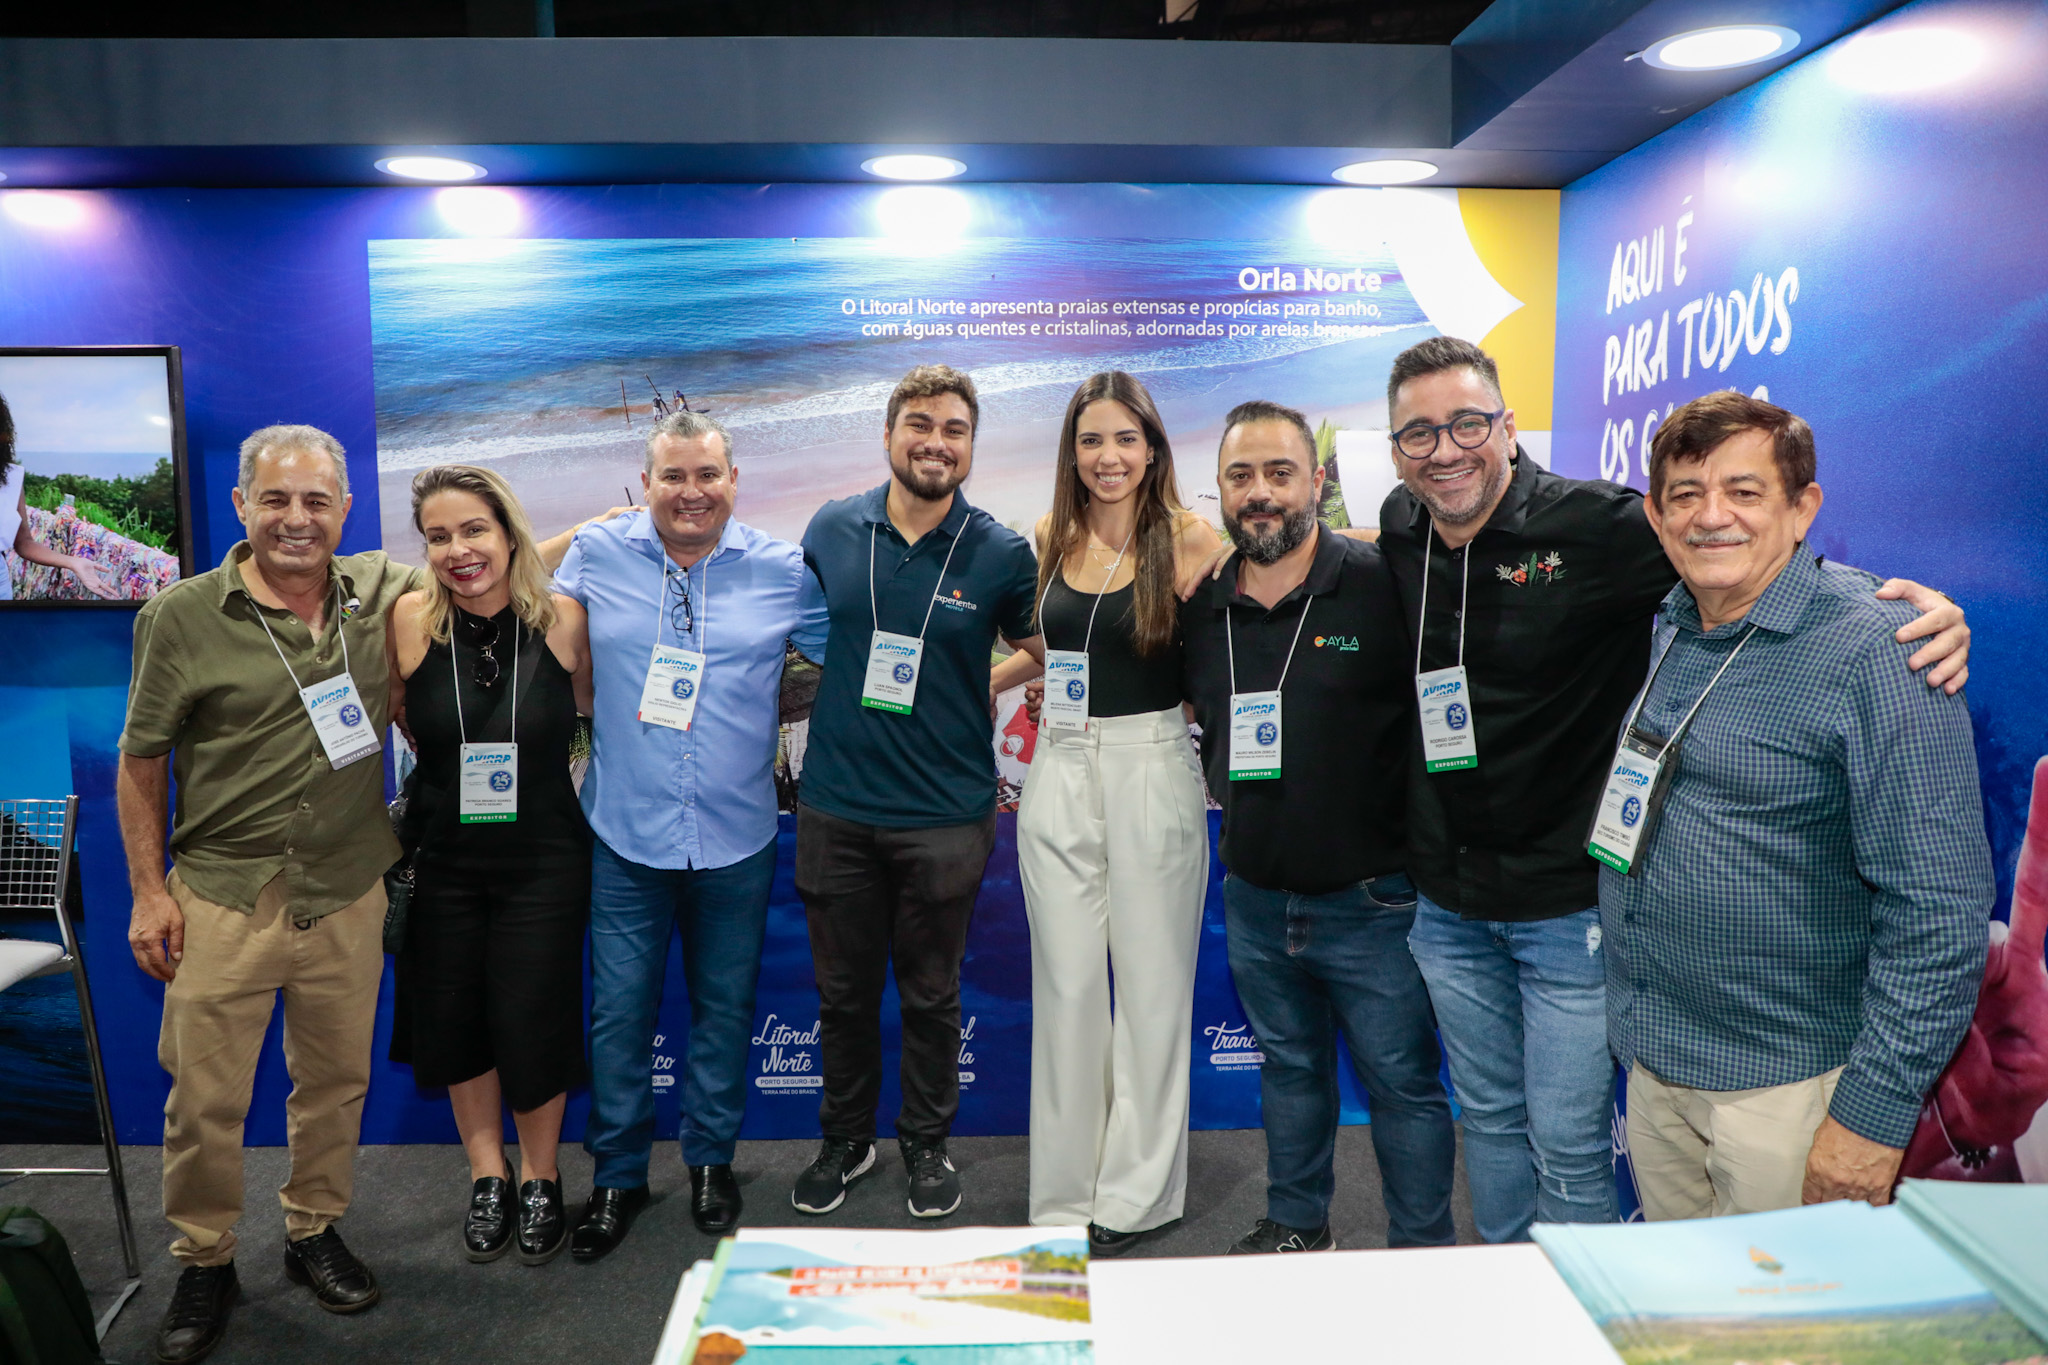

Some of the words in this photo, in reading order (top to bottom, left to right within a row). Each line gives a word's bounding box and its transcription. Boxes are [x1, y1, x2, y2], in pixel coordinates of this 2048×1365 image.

[1606, 225, 1664, 314] AQUI
[1674, 195, 1694, 286] É
[1238, 267, 1296, 291] Orla
[1304, 268, 1382, 292] Norte
[841, 298, 856, 315] O
[860, 298, 913, 315] Litoral
[918, 298, 966, 315] Norte
[970, 300, 1054, 318] apresenta
[1058, 299, 1108, 318] praias
[1112, 300, 1186, 315] extensas
[1189, 302, 1200, 315] e
[1204, 299, 1280, 318] propícias
[1284, 303, 1320, 319] para
[1325, 300, 1382, 318] banho,
[861, 323, 899, 336] com
[903, 320, 953, 339] águas
[957, 321, 1026, 339] quentes
[1030, 323, 1041, 336] e
[1045, 319, 1132, 338] cristalinas,
[1136, 319, 1224, 336] adornadas
[1228, 322, 1258, 339] por
[1261, 321, 1309, 336] areias
[1603, 309, 1669, 406] PARA
[1677, 267, 1800, 378] TODOS
[1327, 636, 1359, 646] AYLA
[896, 667, 911, 679] 25
[675, 682, 691, 695] 25
[1070, 683, 1083, 696] 25
[870, 700, 904, 710] EXPOSITOR
[343, 707, 358, 722] 25
[652, 716, 676, 725] VISITANTE
[1449, 708, 1464, 723] 25
[1260, 726, 1274, 740] 25
[341, 747, 371, 763] VISITANTE
[1435, 760, 1468, 768] EXPOSITOR
[494, 774, 509, 787] 25
[1624, 802, 1640, 820] 25
[1595, 848, 1622, 867] EXPOSITOR
[752, 1014, 820, 1045] Litoral
[1204, 1021, 1258, 1050] Tranc
[762, 1046, 813, 1073] Norte
